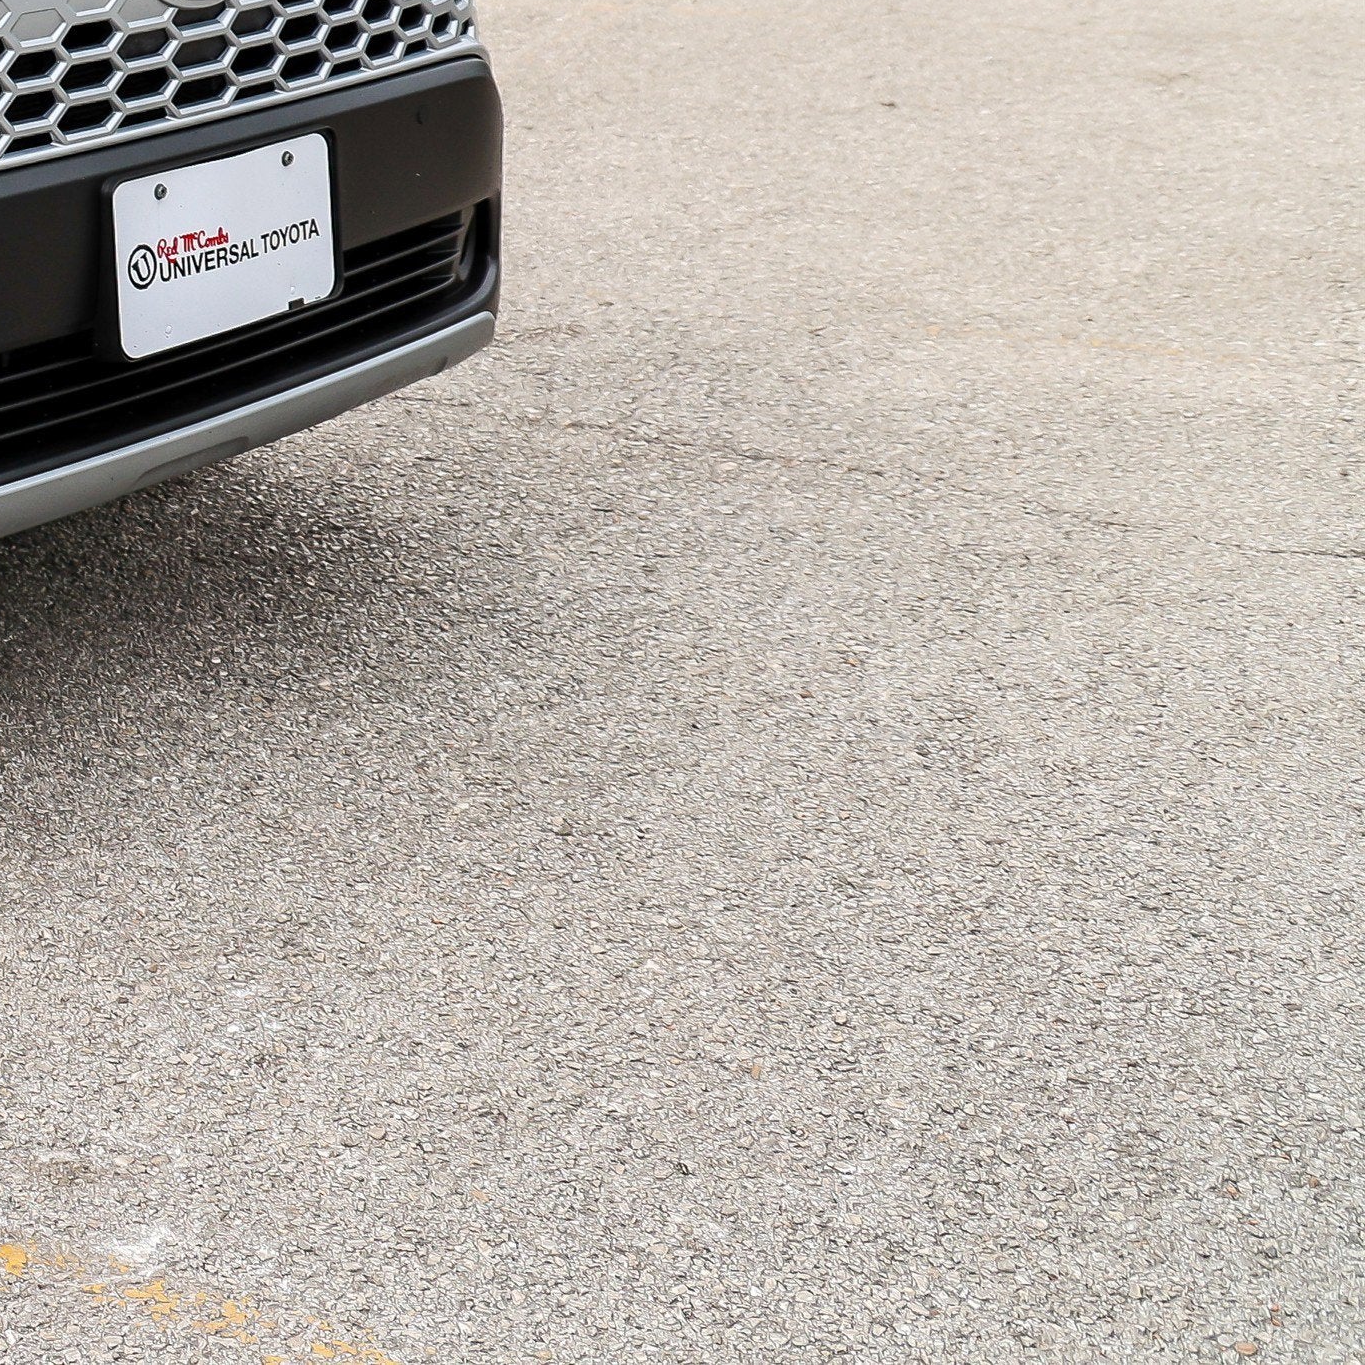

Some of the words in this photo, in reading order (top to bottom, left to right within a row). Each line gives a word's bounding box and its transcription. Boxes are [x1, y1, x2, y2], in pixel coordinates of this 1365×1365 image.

[157, 238, 179, 261] Red
[180, 227, 229, 252] McCombs
[159, 239, 259, 282] UNIVERSAL
[261, 218, 320, 254] TOYOTA
